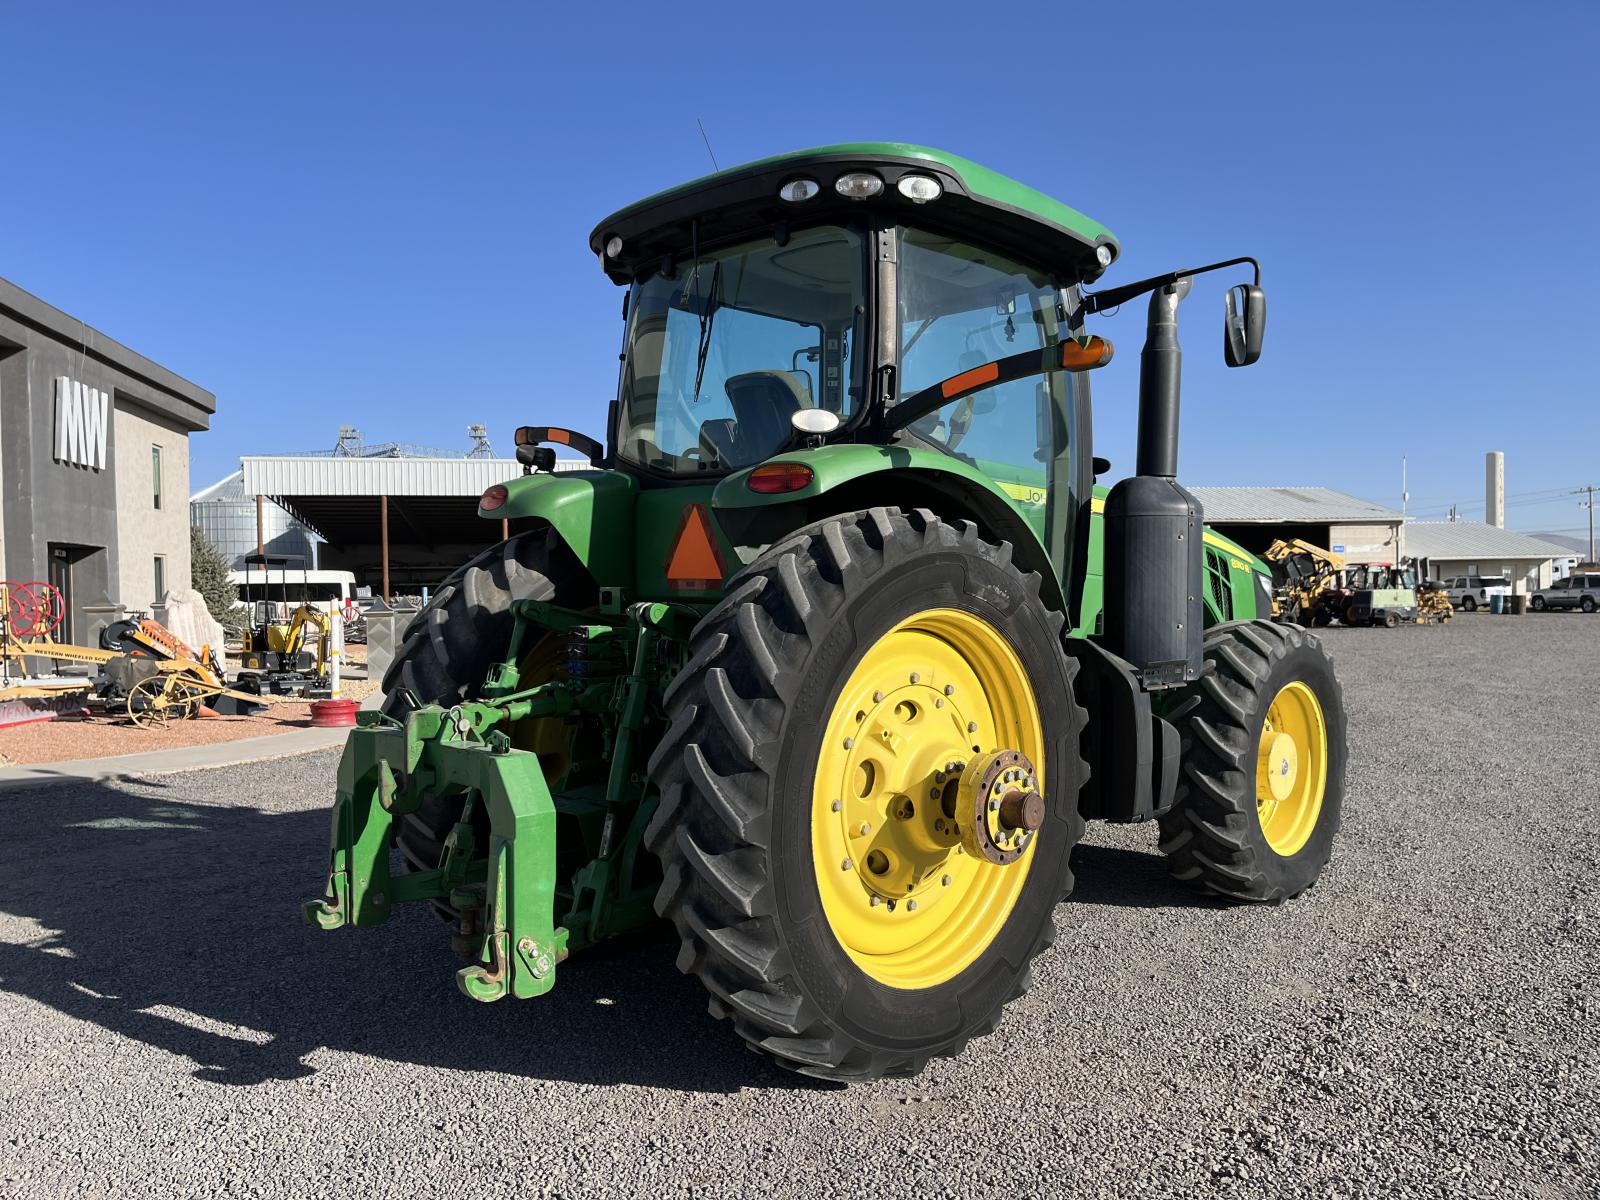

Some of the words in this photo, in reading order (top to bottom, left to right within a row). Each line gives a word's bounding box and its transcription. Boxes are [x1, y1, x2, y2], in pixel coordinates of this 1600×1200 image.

[57, 375, 108, 470] MW
[34, 648, 64, 657] WESTERN
[64, 652, 93, 661] WHEELED
